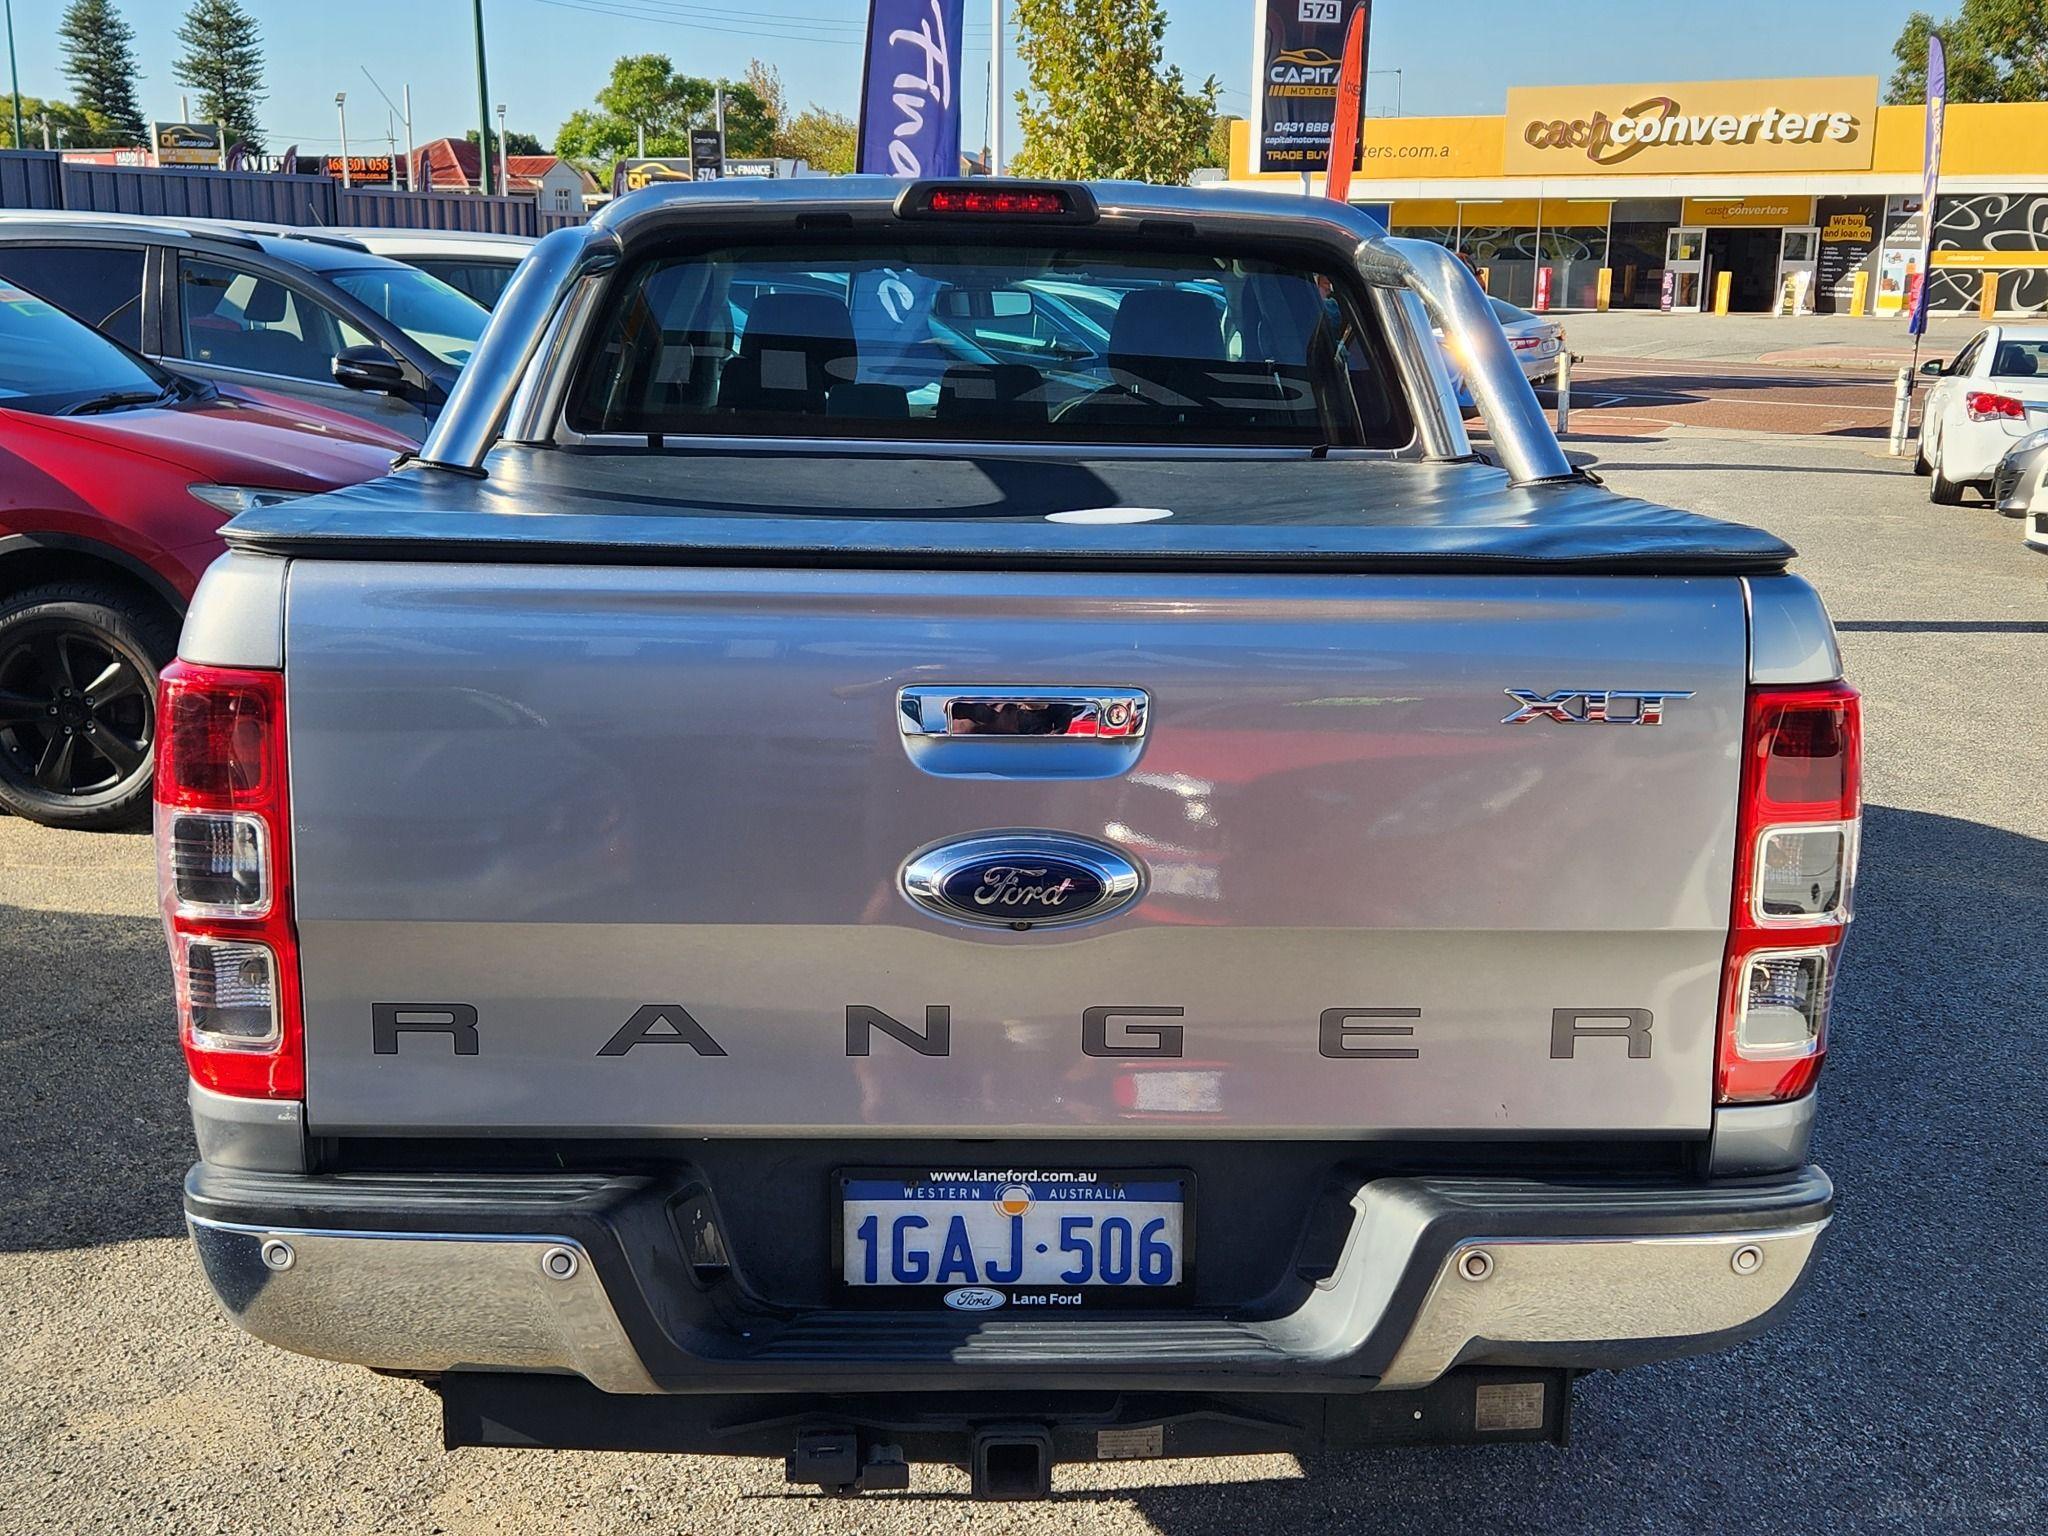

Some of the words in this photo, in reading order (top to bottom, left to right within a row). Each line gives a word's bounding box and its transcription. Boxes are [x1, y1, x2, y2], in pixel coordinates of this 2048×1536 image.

[1303, 2, 1337, 19] 579
[1290, 86, 1336, 96] MOTORS
[1274, 121, 1305, 133] 0431
[1305, 121, 1330, 133] 888
[1266, 150, 1303, 160] TRADE
[1306, 150, 1329, 160] BUY
[369, 158, 389, 171] 058
[737, 165, 771, 175] FINANCE
[698, 167, 717, 181] 574
[1832, 216, 1847, 226] We
[1847, 216, 1864, 228] buy
[1824, 229, 1840, 238] and
[1840, 229, 1858, 238] loan
[1859, 230, 1871, 238] on
[1501, 688, 1697, 725] XLT
[973, 866, 1075, 906] Ford
[371, 1002, 1653, 1060] RANGER
[929, 1169, 1098, 1183] www.laneford.com.au
[903, 1186, 980, 1200] WESTERN
[1049, 1187, 1127, 1200] AUSTRALIA
[956, 1289, 998, 1308] Ford
[1012, 1292, 1047, 1306] Lane
[1049, 1292, 1082, 1306] Ford
